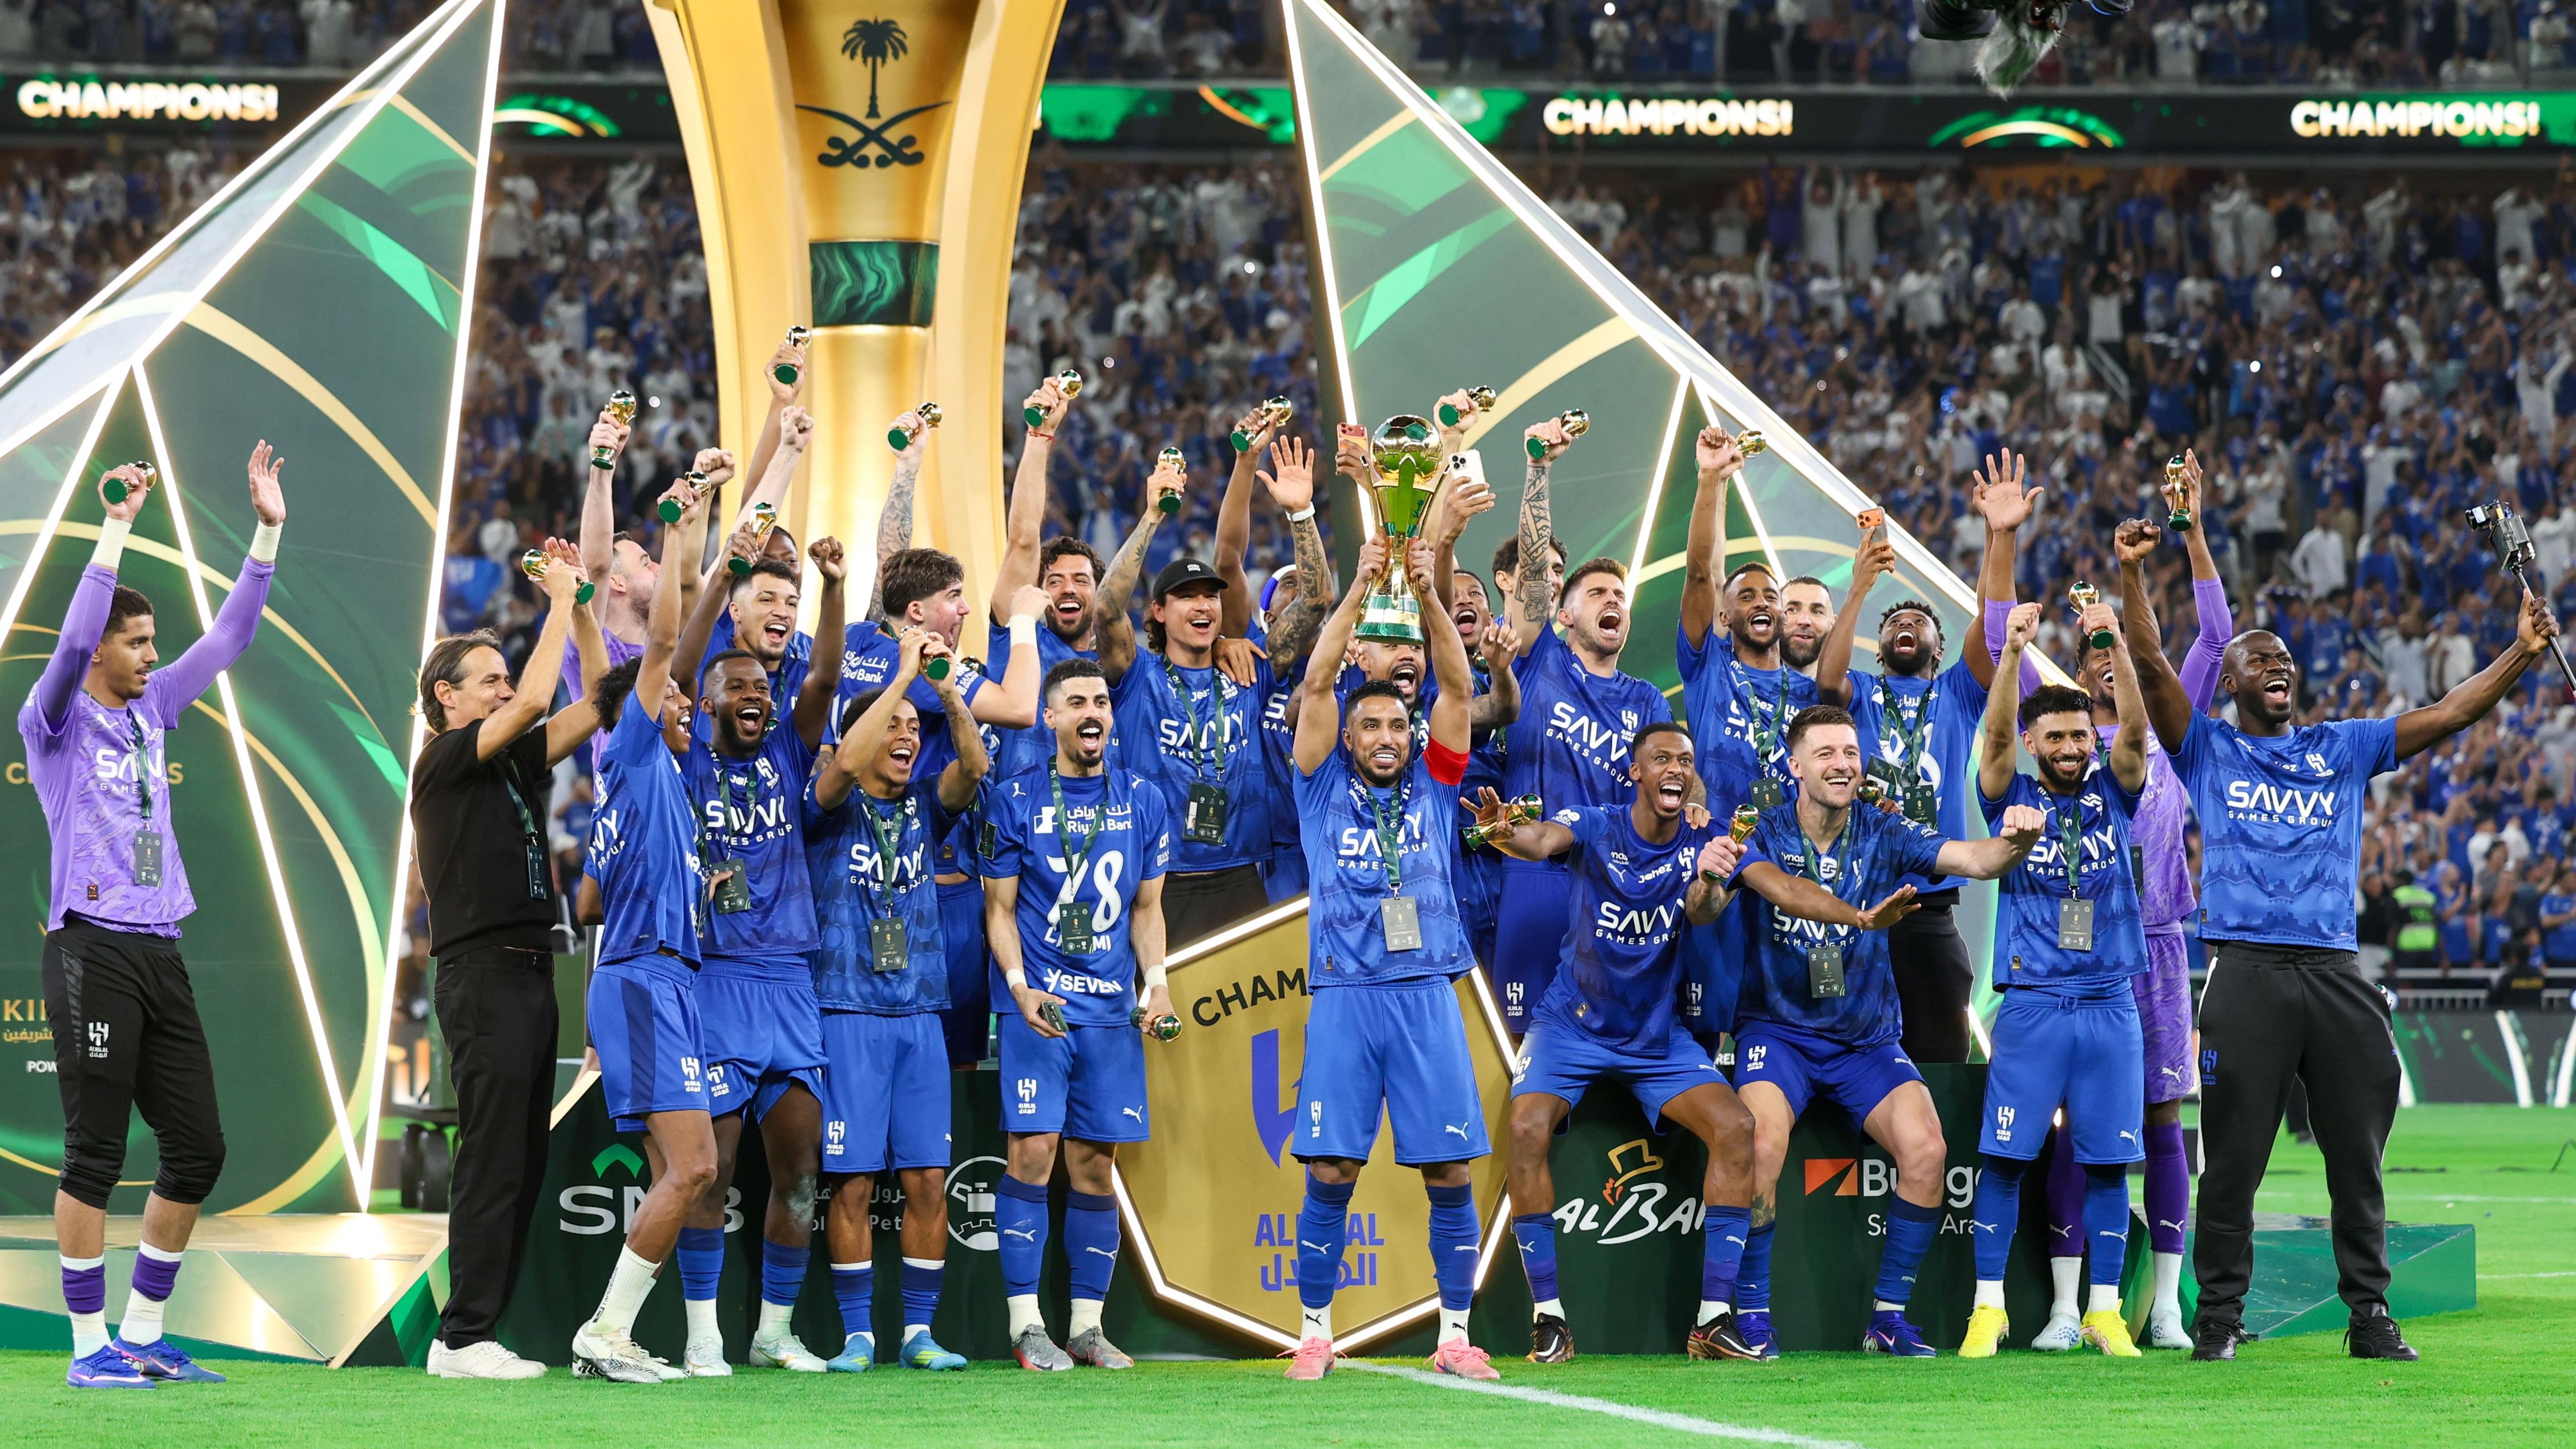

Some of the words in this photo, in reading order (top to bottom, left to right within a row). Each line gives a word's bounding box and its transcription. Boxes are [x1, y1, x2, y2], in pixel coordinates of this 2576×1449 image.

[18, 80, 278, 120] CHAMPIONS!
[1543, 98, 1793, 135] CHAMPIONS!
[2291, 100, 2539, 137] CHAMPIONS!
[857, 669, 884, 683] Bank
[1263, 721, 1293, 735] GAM
[1550, 702, 1627, 762] SAVV
[1546, 728, 1589, 757] GAMES
[1593, 756, 1633, 787] GROUP
[100, 783, 141, 795] GAME
[2227, 780, 2334, 818] SAVVY
[2228, 811, 2280, 823] GAMES
[705, 832, 749, 846] GAMES
[1638, 863, 1673, 884] Jahez
[2027, 864, 2064, 876] GAME
[2081, 856, 2116, 873] GROU
[851, 876, 881, 891] GAME
[1046, 850, 1124, 933] 78
[1597, 898, 1685, 935] SAVV
[1596, 929, 1645, 945] GAMES
[1193, 968, 1307, 1027] CHAM
[26, 1060, 57, 1073] POW
[870, 1215, 901, 1230] Pet
